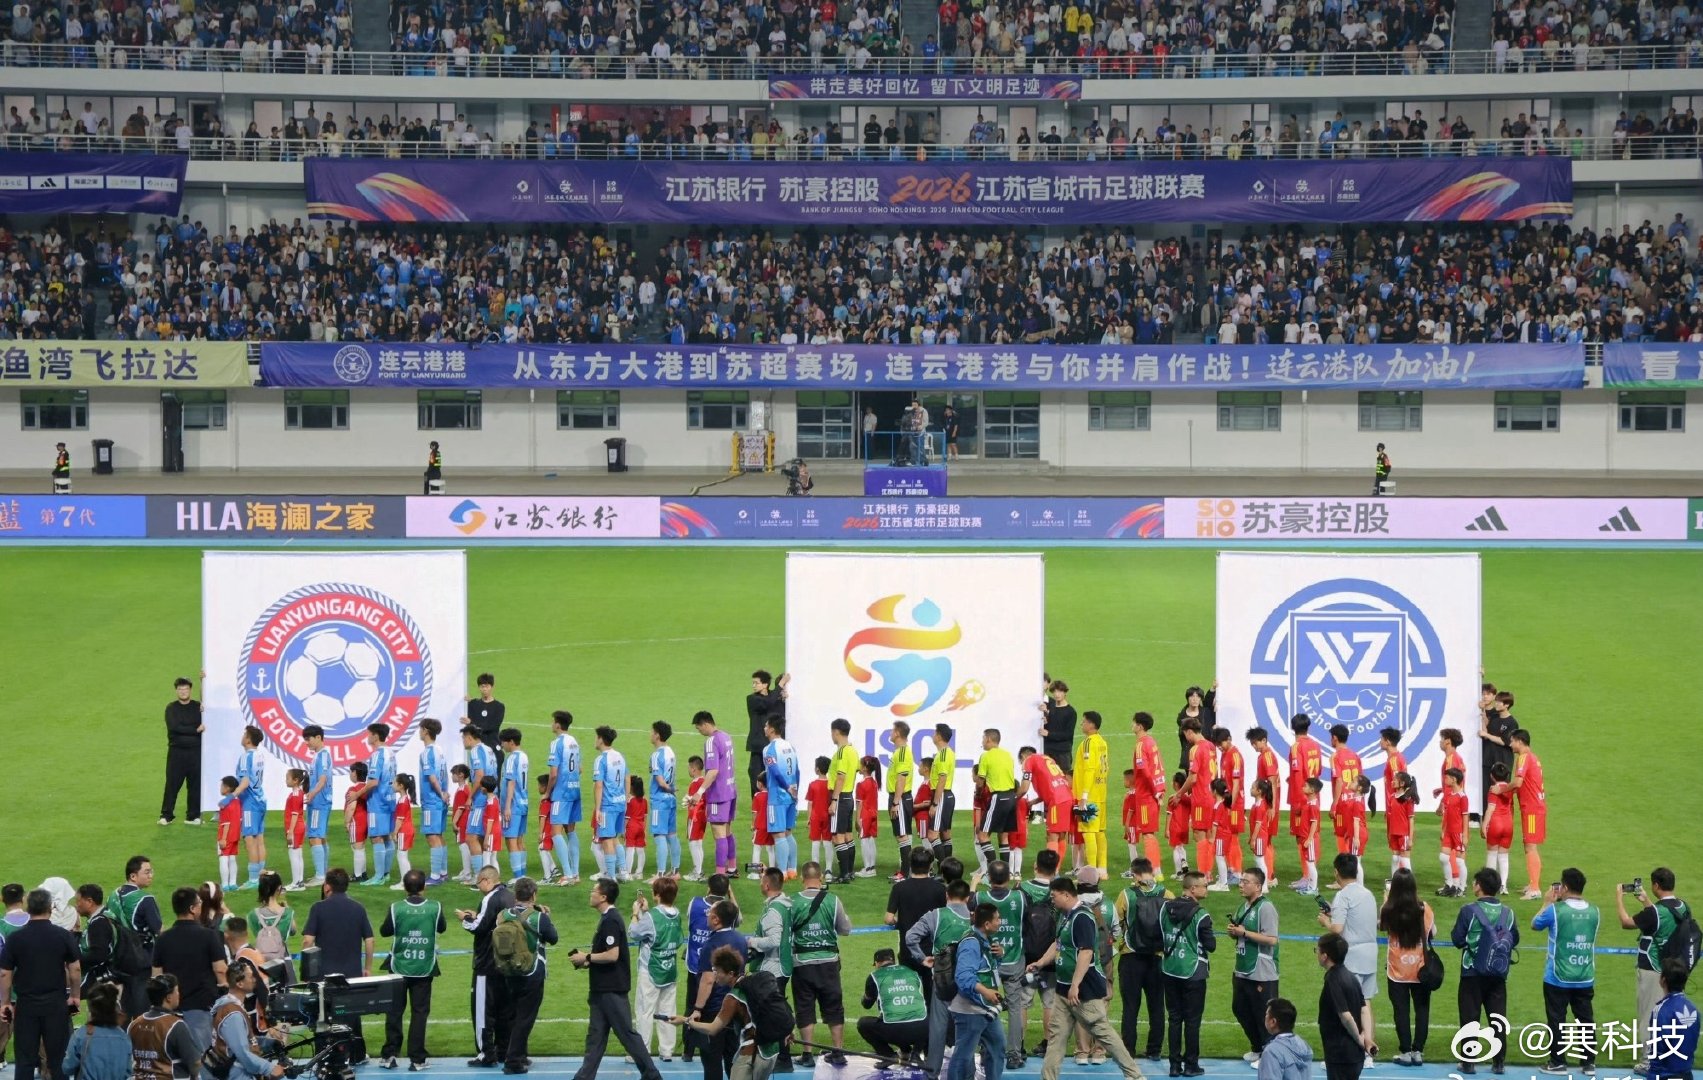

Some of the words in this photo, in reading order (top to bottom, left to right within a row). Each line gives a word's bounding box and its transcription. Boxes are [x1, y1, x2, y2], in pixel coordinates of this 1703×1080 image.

[810, 78, 920, 95] 带走美好回忆
[931, 78, 1040, 95] 留下文明足迹
[666, 177, 766, 201] 江苏银行
[779, 177, 879, 201] 苏豪控股
[890, 172, 971, 204] 2026
[976, 174, 1204, 201] 江苏省城市足球联赛
[0, 346, 198, 381] 渔湾飞拉达
[379, 350, 466, 371] 连云港港
[1641, 351, 1703, 380] 看
[176, 501, 243, 531] HLA
[246, 502, 375, 531] 海澜之家
[863, 503, 909, 515] 江苏银行
[915, 503, 961, 515] 苏豪控股
[1242, 502, 1390, 534] 苏豪控股
[880, 517, 982, 528] 江苏省城市足球联赛
[259, 598, 384, 657] LIANYUNGANG
[380, 620, 413, 656] CITY
[1298, 692, 1333, 730] Xuzho
[1347, 693, 1398, 735] Football
[260, 707, 356, 762] FOOTLL
[361, 706, 409, 753] TAM
[1166, 934, 1188, 943] PHTO
[1566, 942, 1592, 950] PHOTO
[403, 949, 426, 960] G18
[1569, 954, 1589, 966] G04
[888, 985, 915, 993] PHOTO
[892, 995, 915, 1006] G07
